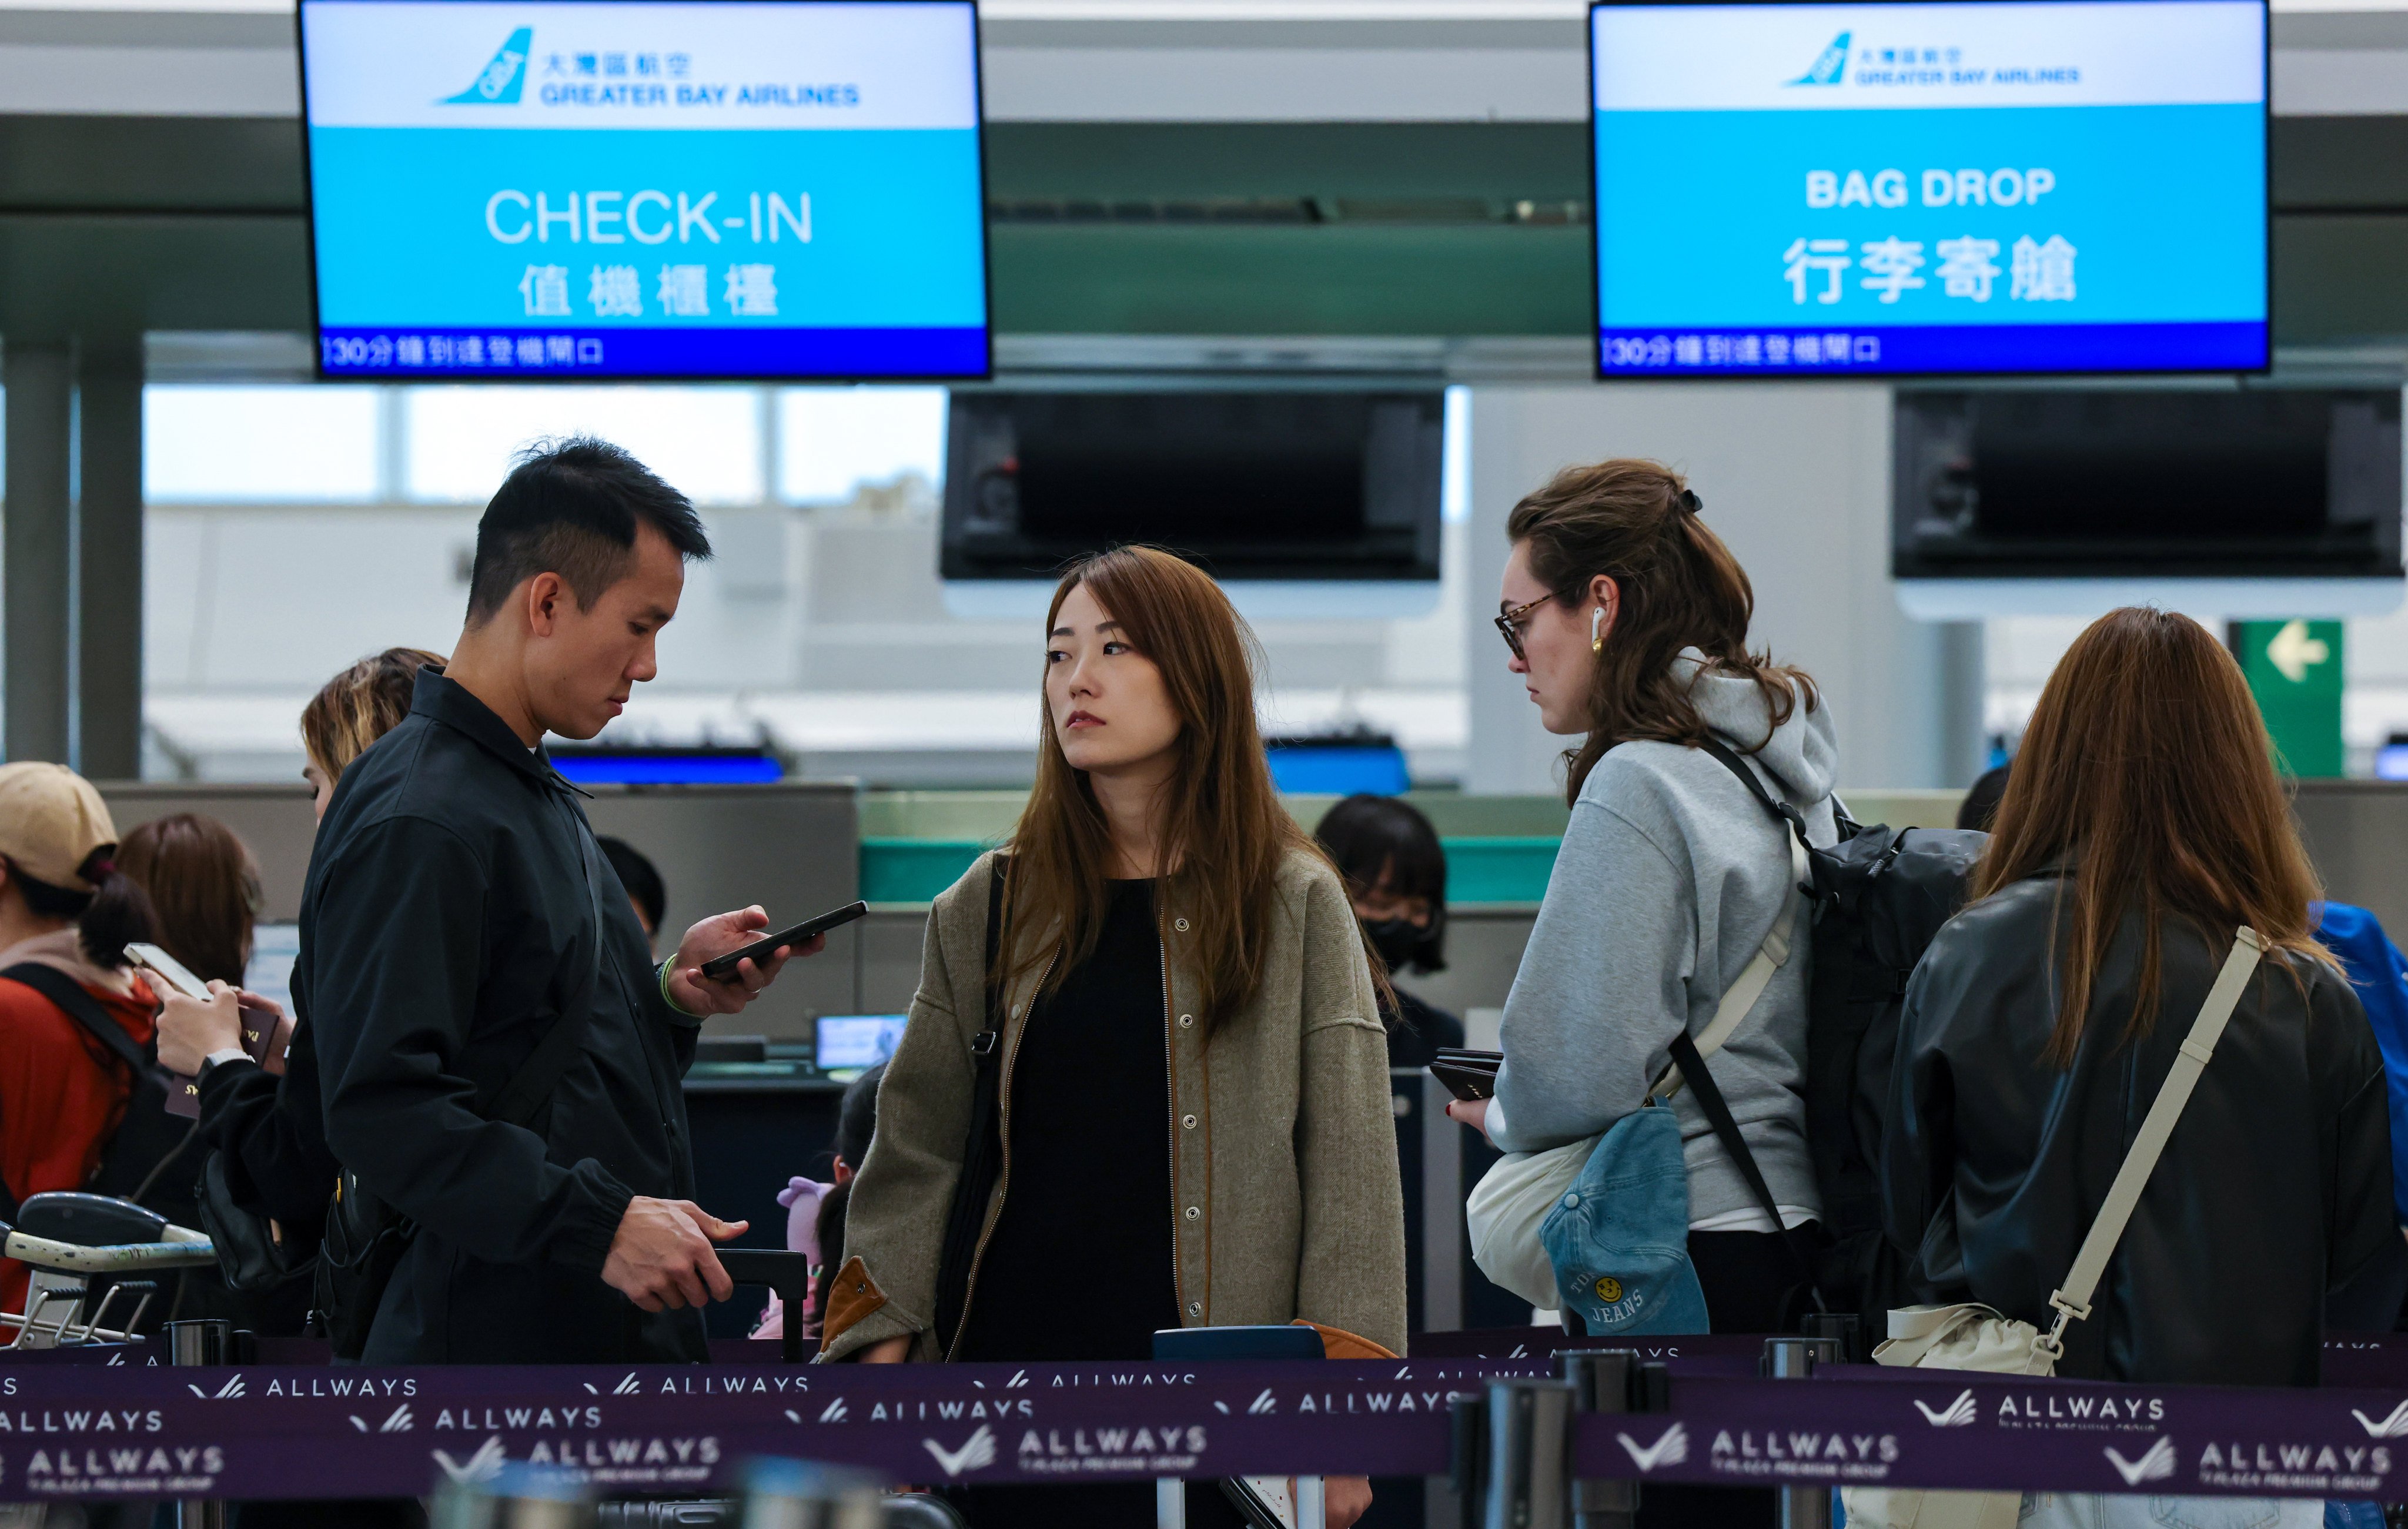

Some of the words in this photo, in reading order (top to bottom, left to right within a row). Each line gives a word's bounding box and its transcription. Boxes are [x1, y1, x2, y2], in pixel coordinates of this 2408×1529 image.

[1855, 69, 1944, 86] GREATER
[1949, 69, 1986, 85] BAY
[1992, 68, 2081, 85] AIRLINES
[540, 83, 668, 106] GREATER
[675, 85, 727, 106] BAY
[736, 85, 860, 106] AIRLINES
[1806, 169, 1909, 209] BAG
[1922, 168, 2057, 208] DROP
[485, 189, 813, 245] CHECK-IN
[1782, 234, 2078, 305] 行李寄艙
[1591, 1289, 1643, 1323] JEANS
[266, 1379, 417, 1397] ALLWAYS
[661, 1377, 808, 1394] ALLWAYS
[435, 1406, 601, 1431] ALLWAYS
[1999, 1395, 2165, 1420] ALLWAYS
[530, 1436, 721, 1465] ALLWAYS
[1018, 1426, 1208, 1456] ALLWAYS
[1711, 1430, 1899, 1462] ALLWAYS
[28, 1446, 224, 1474] ALLWAYS
[2199, 1441, 2392, 1474] ALLWAYS
